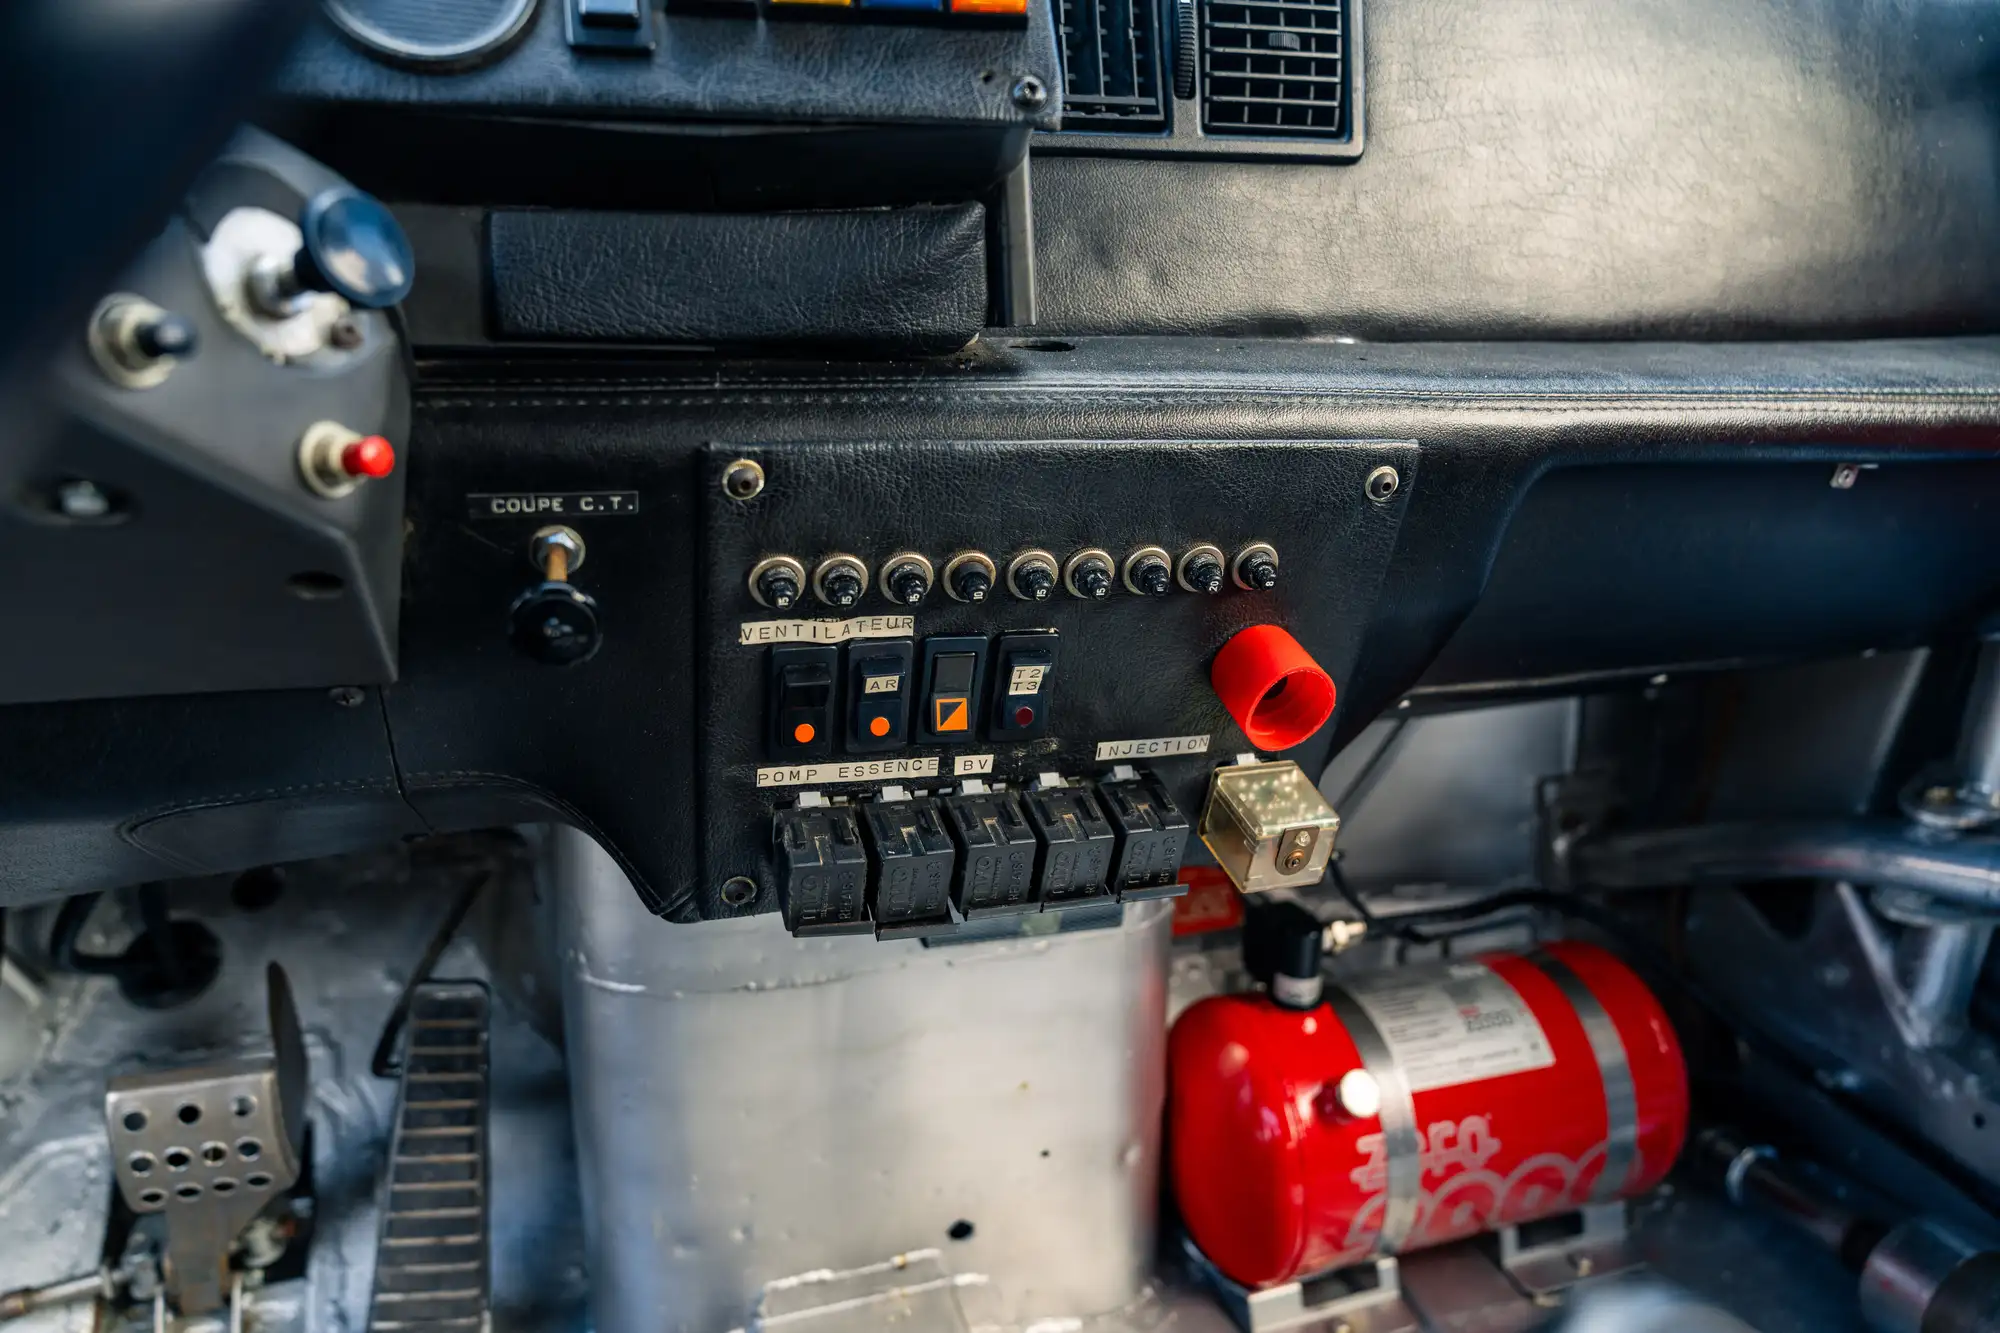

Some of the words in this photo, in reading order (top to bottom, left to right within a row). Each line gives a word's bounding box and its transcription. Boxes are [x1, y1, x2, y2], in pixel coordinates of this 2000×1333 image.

[491, 497, 564, 513] COUPE
[580, 496, 634, 511] C.T.
[1095, 587, 1106, 597] 15
[1208, 580, 1220, 592] 20
[908, 592, 920, 603] 15
[973, 591, 984, 600] 10
[1036, 588, 1047, 598] 15
[778, 596, 789, 607] 15
[841, 595, 852, 605] 15
[741, 617, 914, 641] VENTILATEUR
[869, 678, 897, 691] AR
[1097, 737, 1209, 758] INJECTION
[962, 758, 989, 772] BV
[757, 769, 818, 785] POMP
[838, 758, 939, 779] ESSENCE
